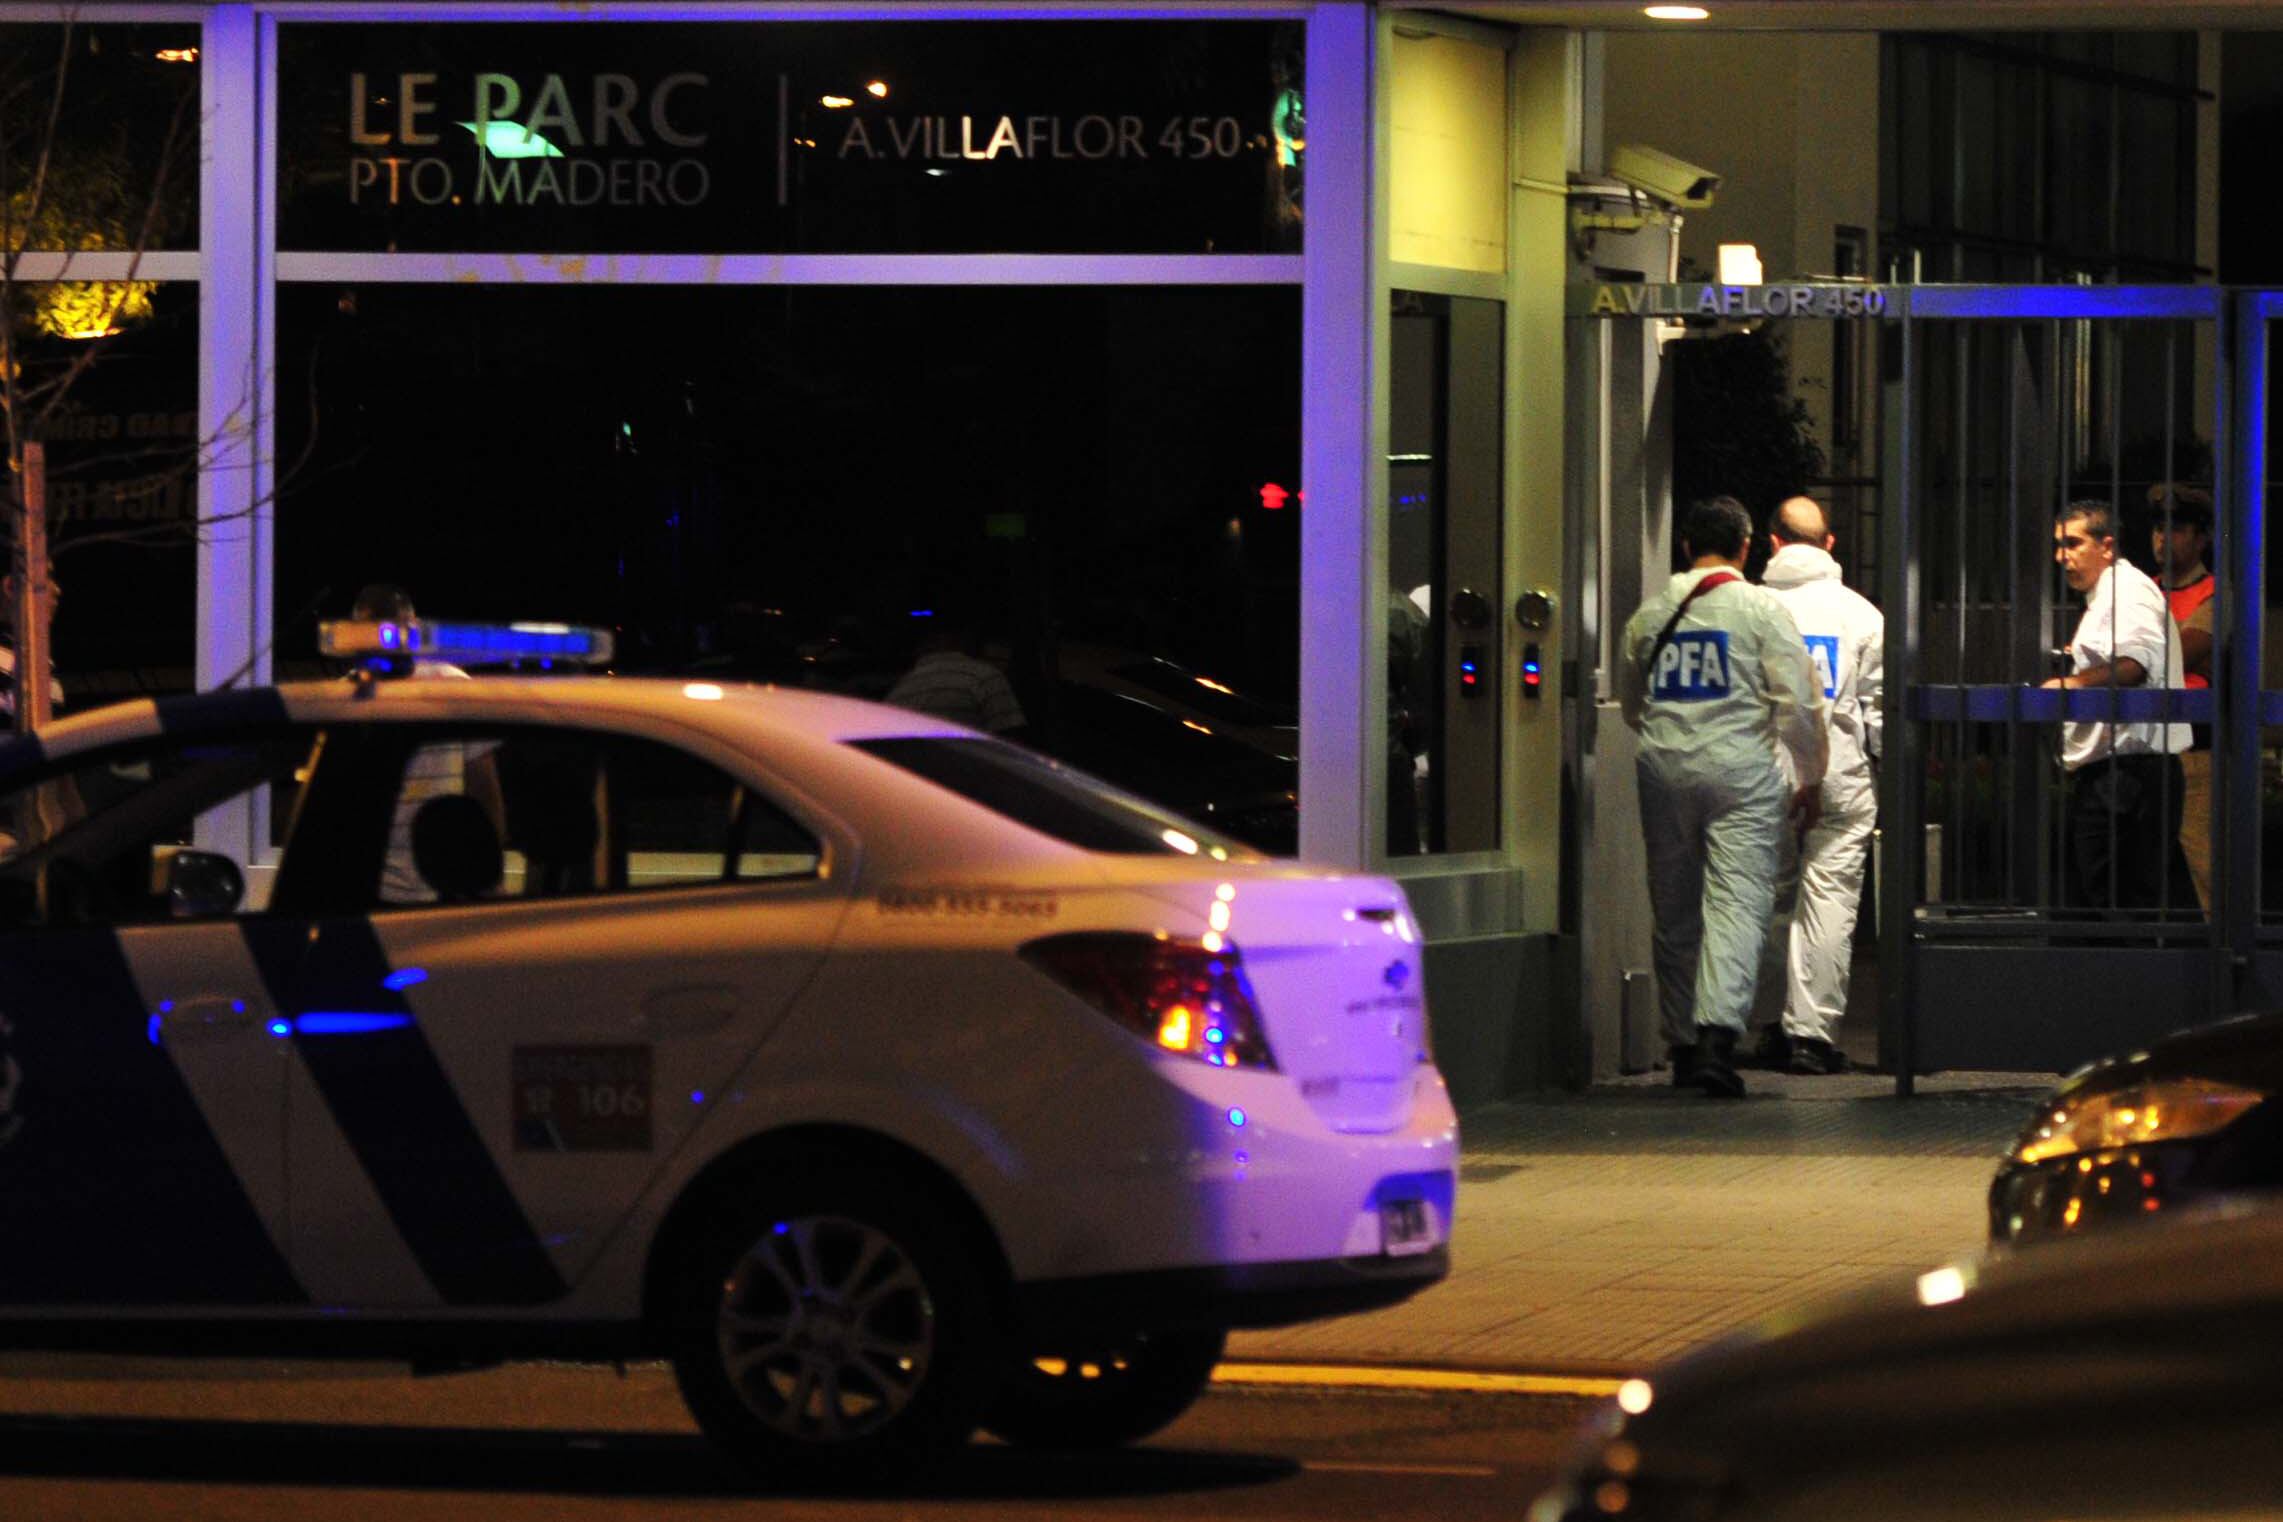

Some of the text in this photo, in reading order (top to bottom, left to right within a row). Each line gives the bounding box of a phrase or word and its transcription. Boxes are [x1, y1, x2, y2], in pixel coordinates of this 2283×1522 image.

[351, 73, 709, 147] LE PARC
[838, 116, 1242, 159] A.VILLAFLOR 450
[351, 158, 710, 206] PTO. MADERO
[1824, 287, 1887, 317] 450
[1657, 641, 1727, 688] PFA
[576, 1083, 645, 1119] 106
